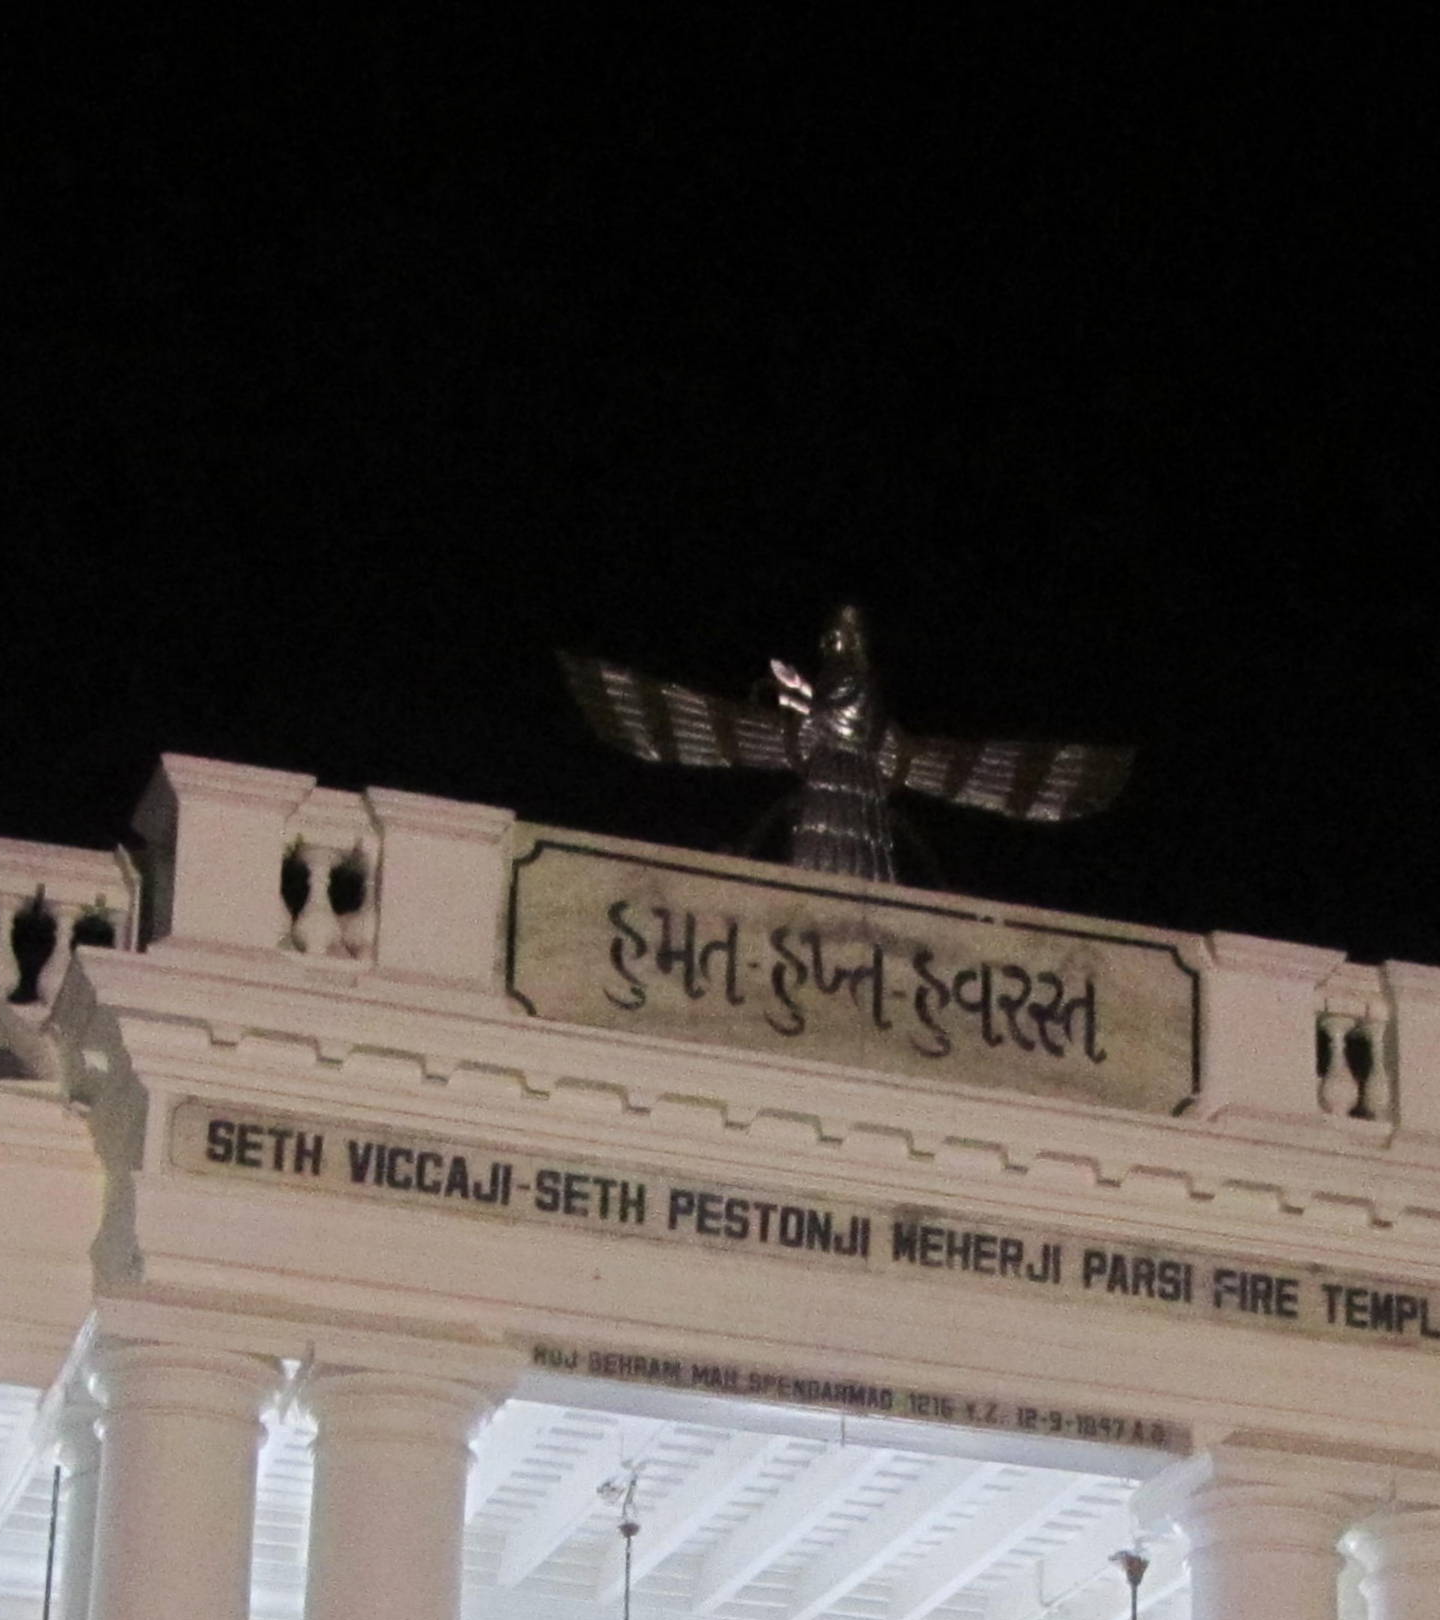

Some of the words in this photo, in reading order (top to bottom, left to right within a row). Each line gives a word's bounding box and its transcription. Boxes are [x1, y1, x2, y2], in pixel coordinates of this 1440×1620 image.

[205, 1118, 324, 1177] SETH
[667, 1187, 871, 1257] PESTONJI
[892, 1217, 1061, 1286] MEHERJI
[1082, 1250, 1193, 1304] PARSI
[1212, 1269, 1300, 1320] FIRE
